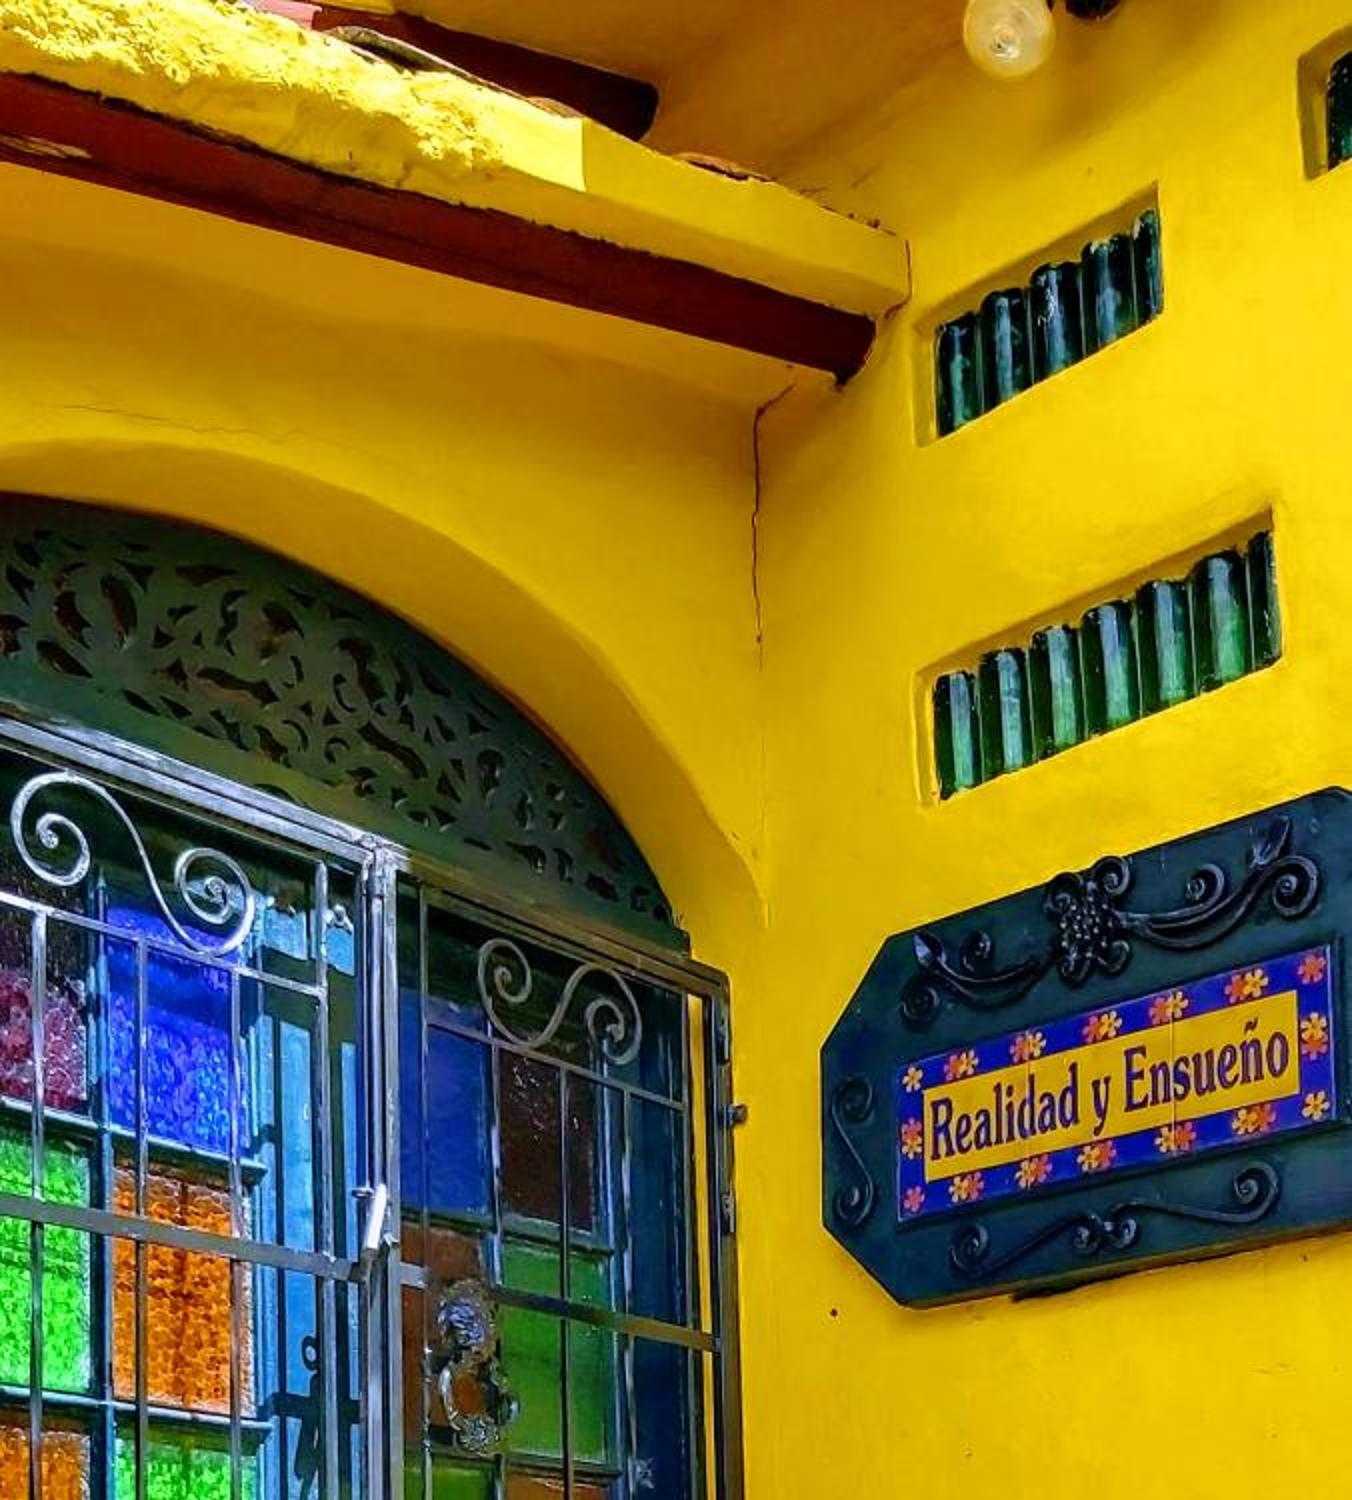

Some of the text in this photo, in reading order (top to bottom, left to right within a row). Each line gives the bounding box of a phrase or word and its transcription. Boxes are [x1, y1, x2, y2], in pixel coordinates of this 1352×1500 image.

[930, 1018, 1290, 1160] Realidad y Ensueño
